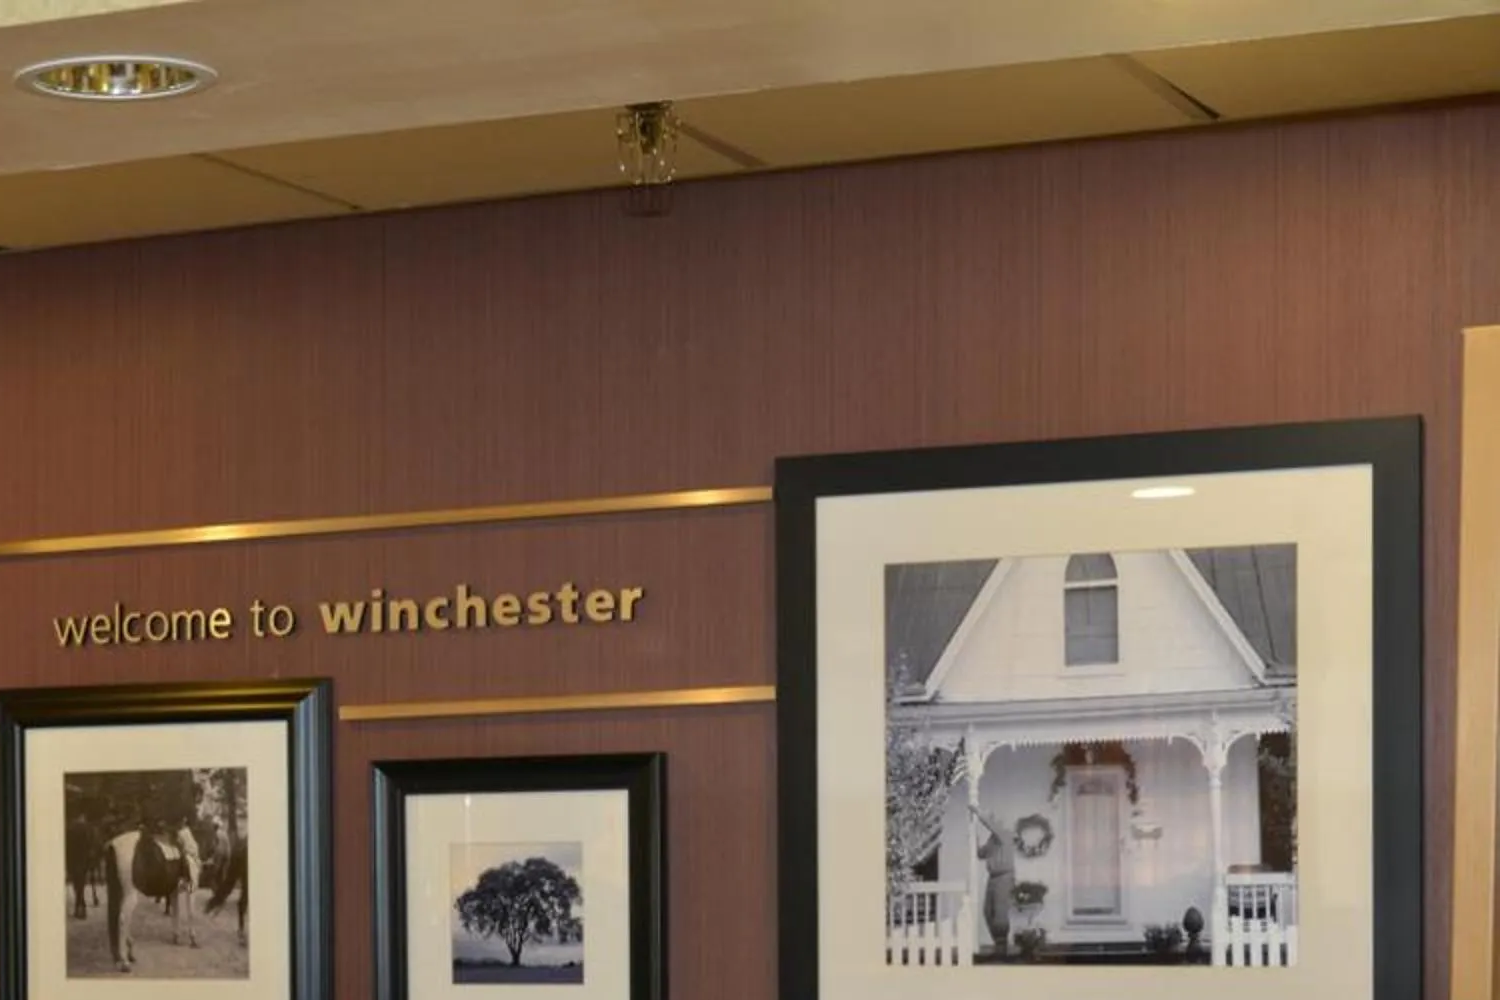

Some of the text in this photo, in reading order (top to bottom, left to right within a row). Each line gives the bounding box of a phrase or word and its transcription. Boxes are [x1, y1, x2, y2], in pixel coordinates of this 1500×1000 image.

[53, 582, 643, 647] welcome to winchester
